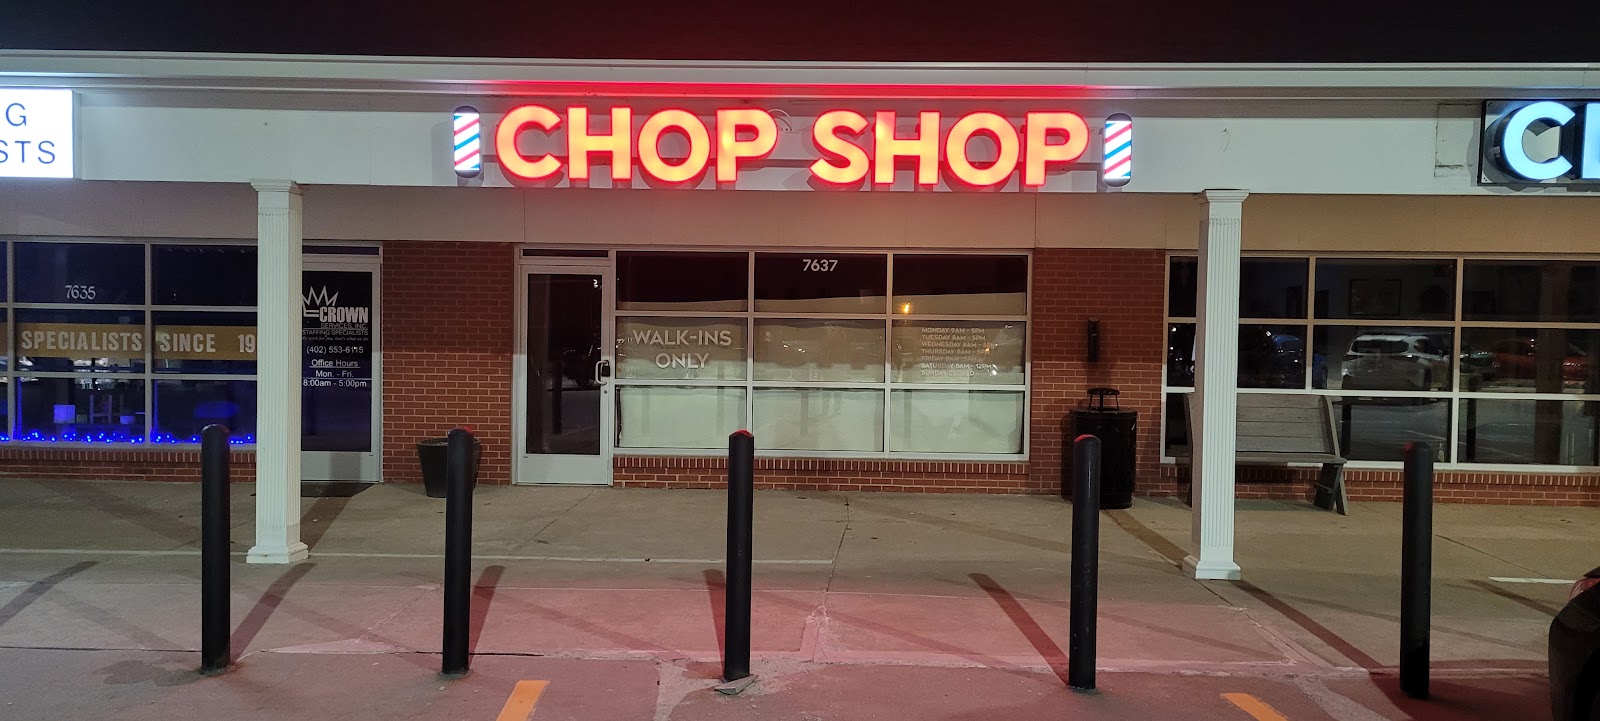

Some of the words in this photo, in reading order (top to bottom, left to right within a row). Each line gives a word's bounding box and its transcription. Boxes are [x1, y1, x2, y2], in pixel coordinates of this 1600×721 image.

[5, 102, 27, 127] G
[496, 104, 778, 182] CHOP
[808, 107, 1090, 186] SHOP
[802, 259, 838, 272] 7637
[65, 285, 96, 300] 7635
[319, 306, 369, 323] CROWN
[21, 330, 142, 351] SPECIALISTS
[159, 333, 216, 353] SINCE
[632, 329, 732, 346] WALK-INS
[307, 346, 327, 354] (402)
[311, 359, 334, 367] Office
[655, 352, 710, 369] ONLY
[339, 380, 367, 388] 5:00pm
